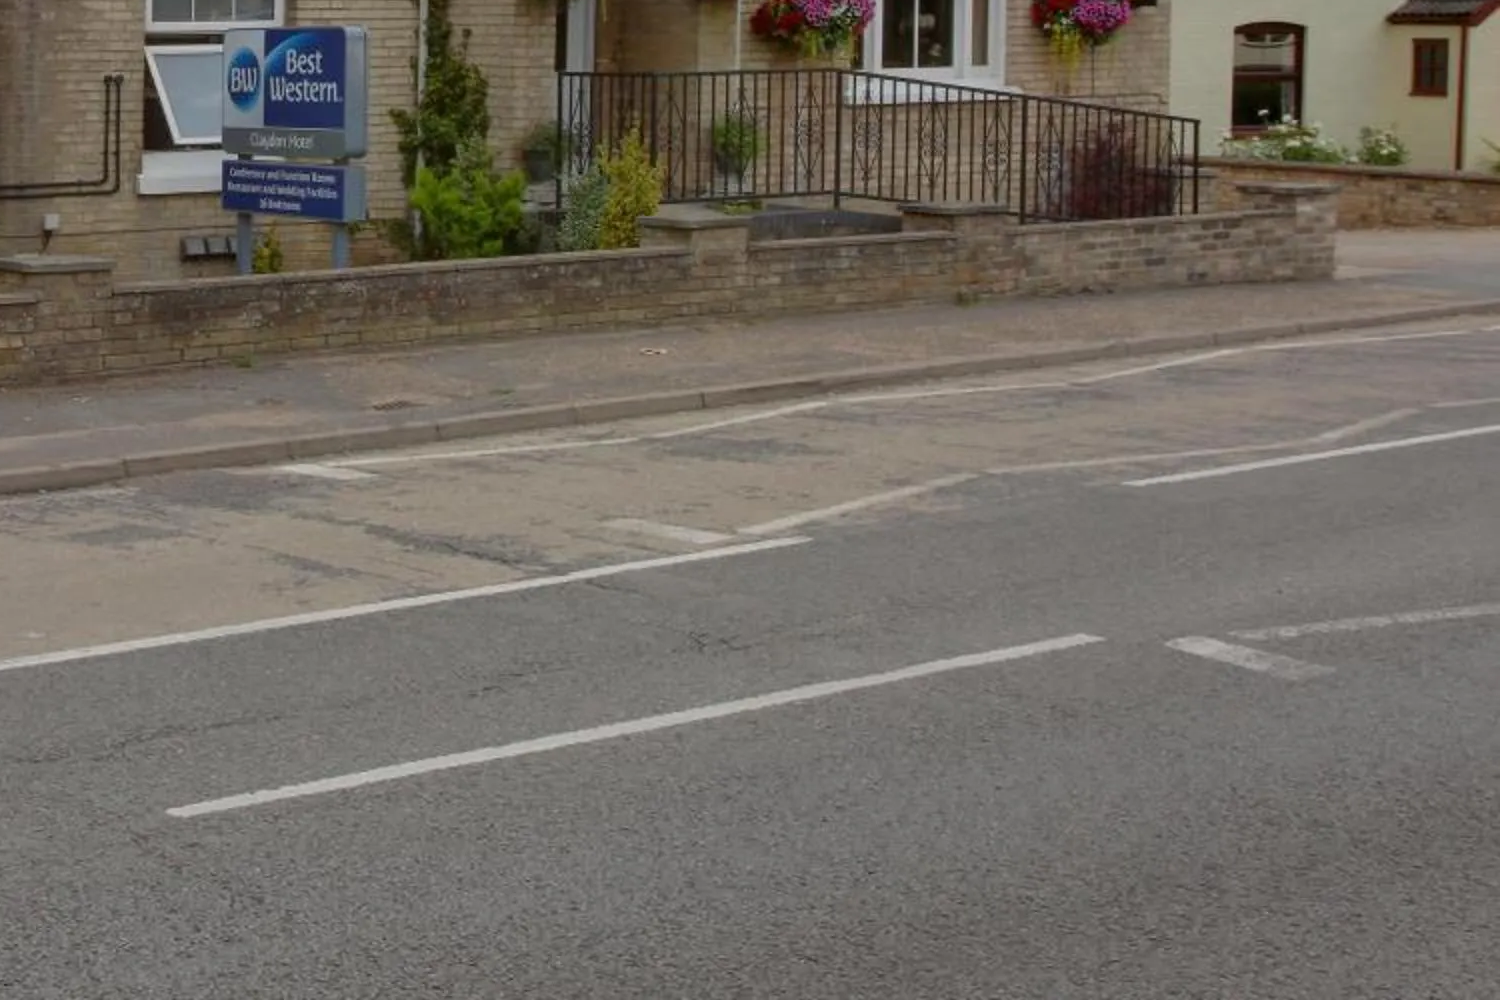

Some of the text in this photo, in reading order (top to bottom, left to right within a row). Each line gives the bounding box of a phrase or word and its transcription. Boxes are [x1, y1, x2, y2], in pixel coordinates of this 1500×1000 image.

[286, 48, 323, 75] Best
[231, 66, 257, 93] BW
[269, 75, 338, 103] Western
[249, 131, 314, 150] Claydon Hotel
